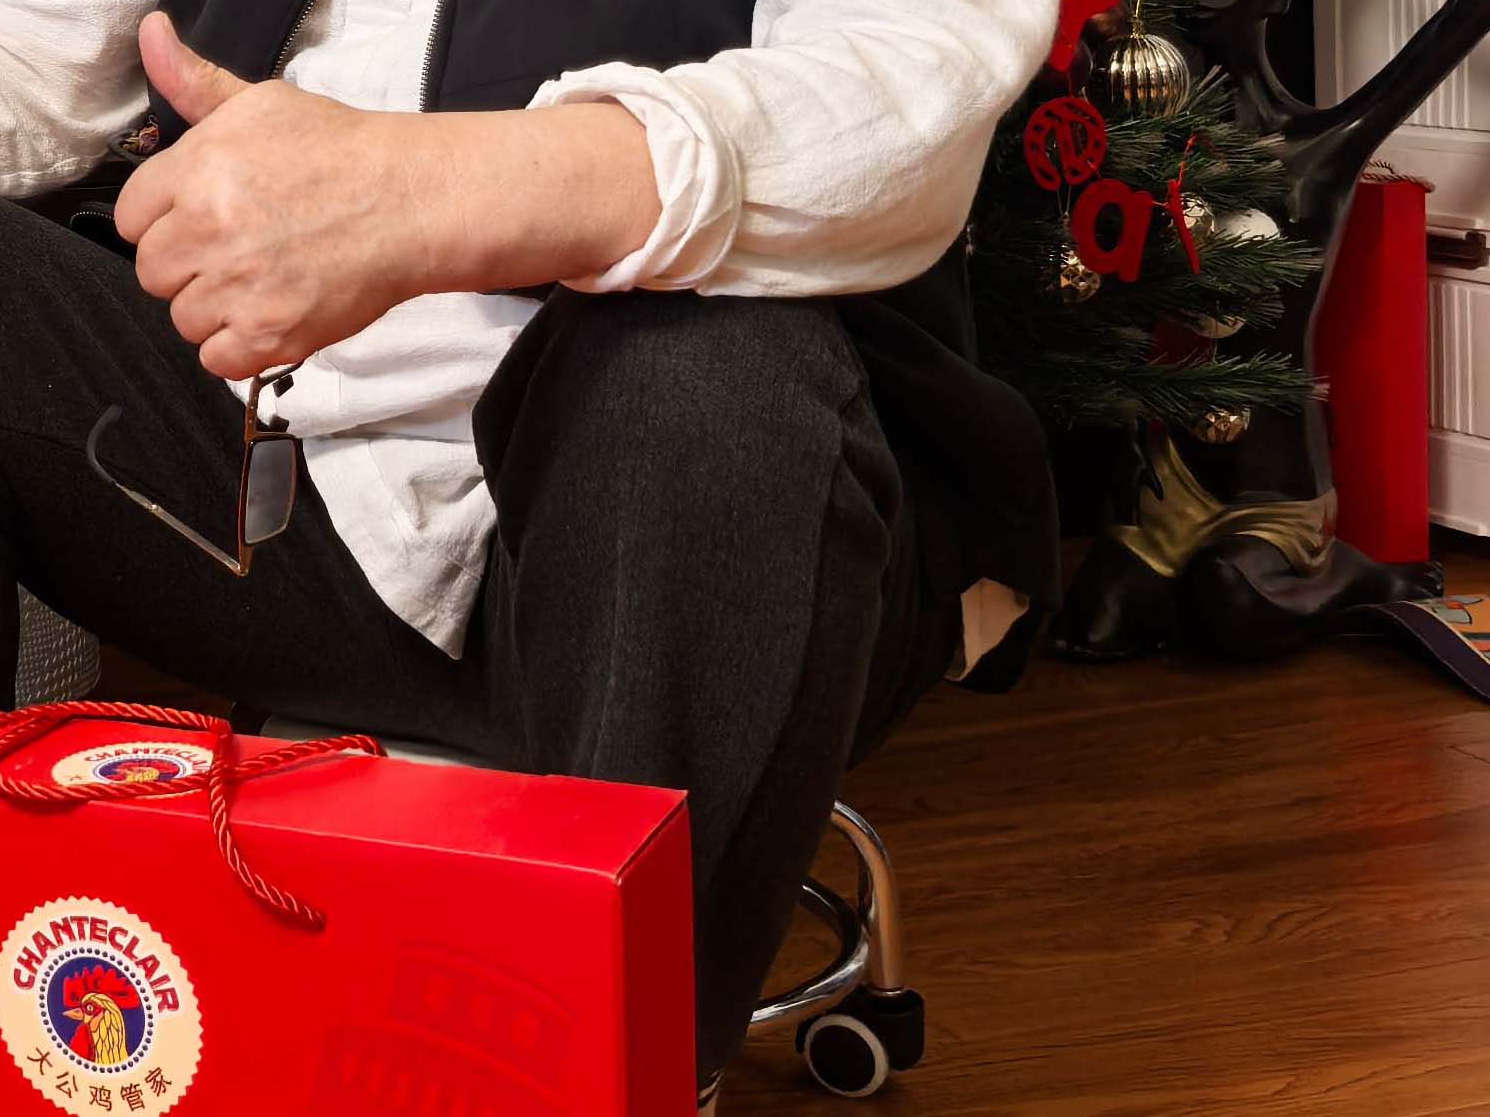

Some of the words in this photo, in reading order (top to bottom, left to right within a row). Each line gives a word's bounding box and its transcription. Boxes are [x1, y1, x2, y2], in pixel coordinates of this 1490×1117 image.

[13, 915, 180, 1013] CHANTECLAIR
[27, 1047, 172, 1112] 大公鸡管家
